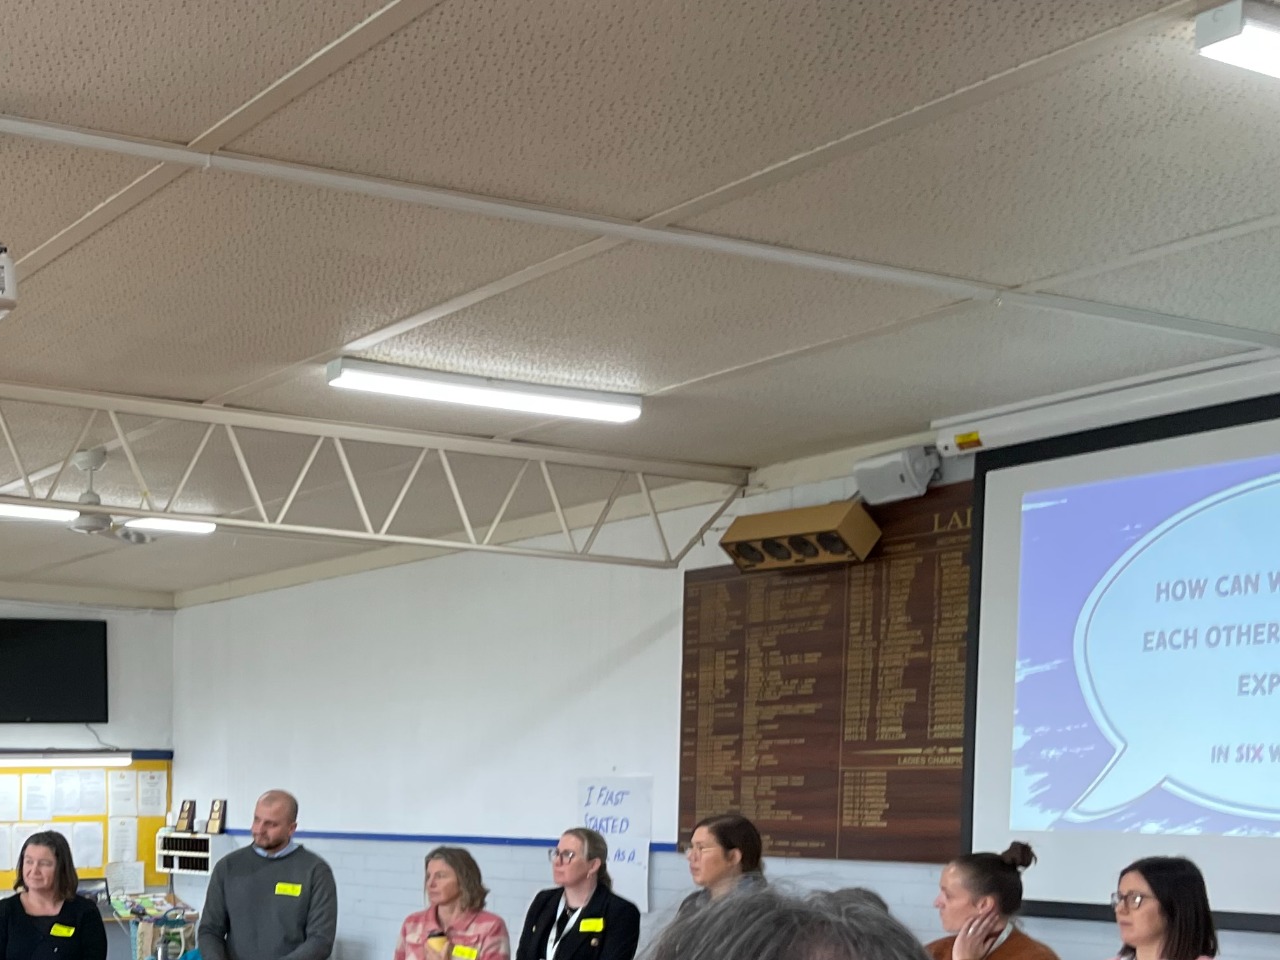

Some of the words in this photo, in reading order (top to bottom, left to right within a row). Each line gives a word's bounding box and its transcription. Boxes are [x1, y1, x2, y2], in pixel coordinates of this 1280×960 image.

[1155, 578, 1208, 602] HOW
[1214, 573, 1260, 597] CAN
[1142, 627, 1198, 652] EACH
[1205, 622, 1280, 648] OTHER
[1237, 672, 1280, 696] EXP
[897, 756, 925, 766] LADIES
[1210, 744, 1230, 763] IN
[1235, 743, 1264, 763] SIX
[584, 785, 595, 807] I
[613, 848, 626, 861] AS
